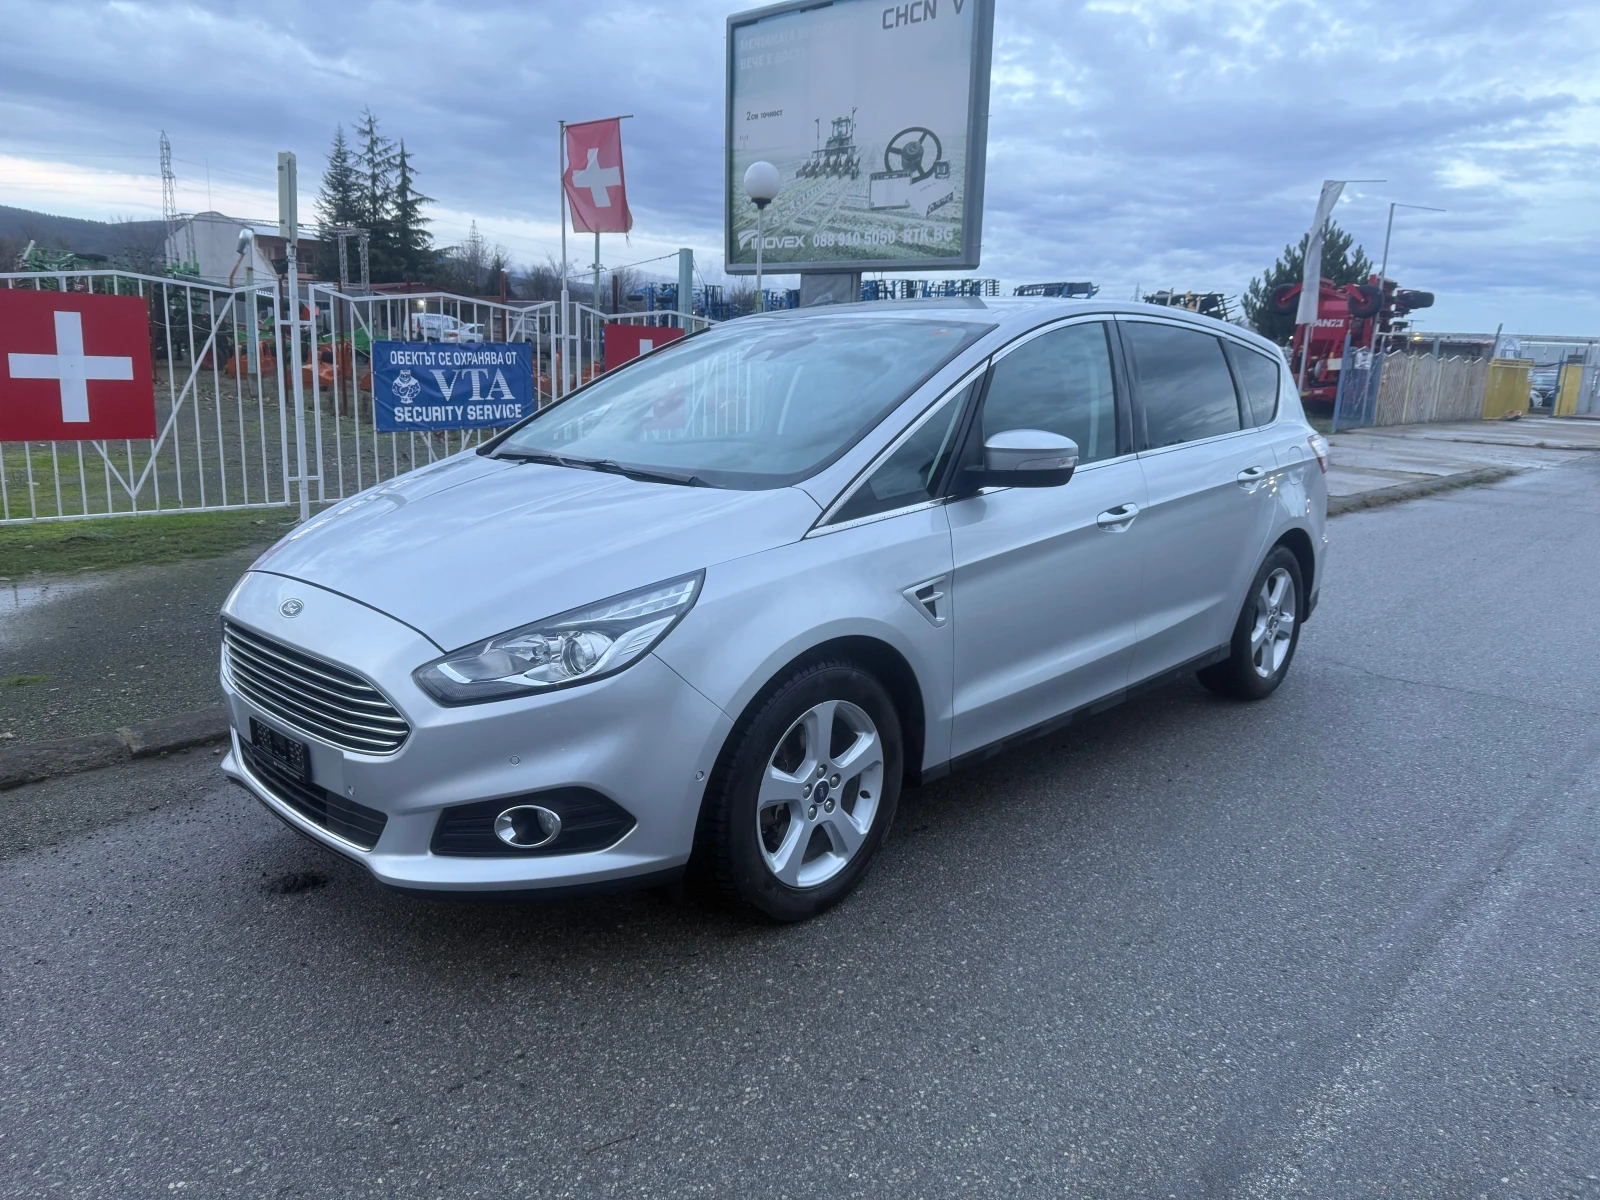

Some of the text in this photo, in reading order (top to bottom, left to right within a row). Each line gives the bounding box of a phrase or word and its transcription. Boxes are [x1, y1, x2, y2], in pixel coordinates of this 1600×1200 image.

[740, 54, 764, 70] ВЕЧЕ
[760, 109, 783, 119] точност
[812, 233, 835, 248] 088
[838, 232, 861, 247] 910
[864, 230, 896, 245] 5050
[903, 227, 954, 243] RTK.BG
[390, 351, 517, 366] ОБЕКТЪТ СЕ ОХРАНЯВА ОТ
[429, 368, 515, 402] VTA
[394, 404, 522, 423] SECURITY SERVICE
